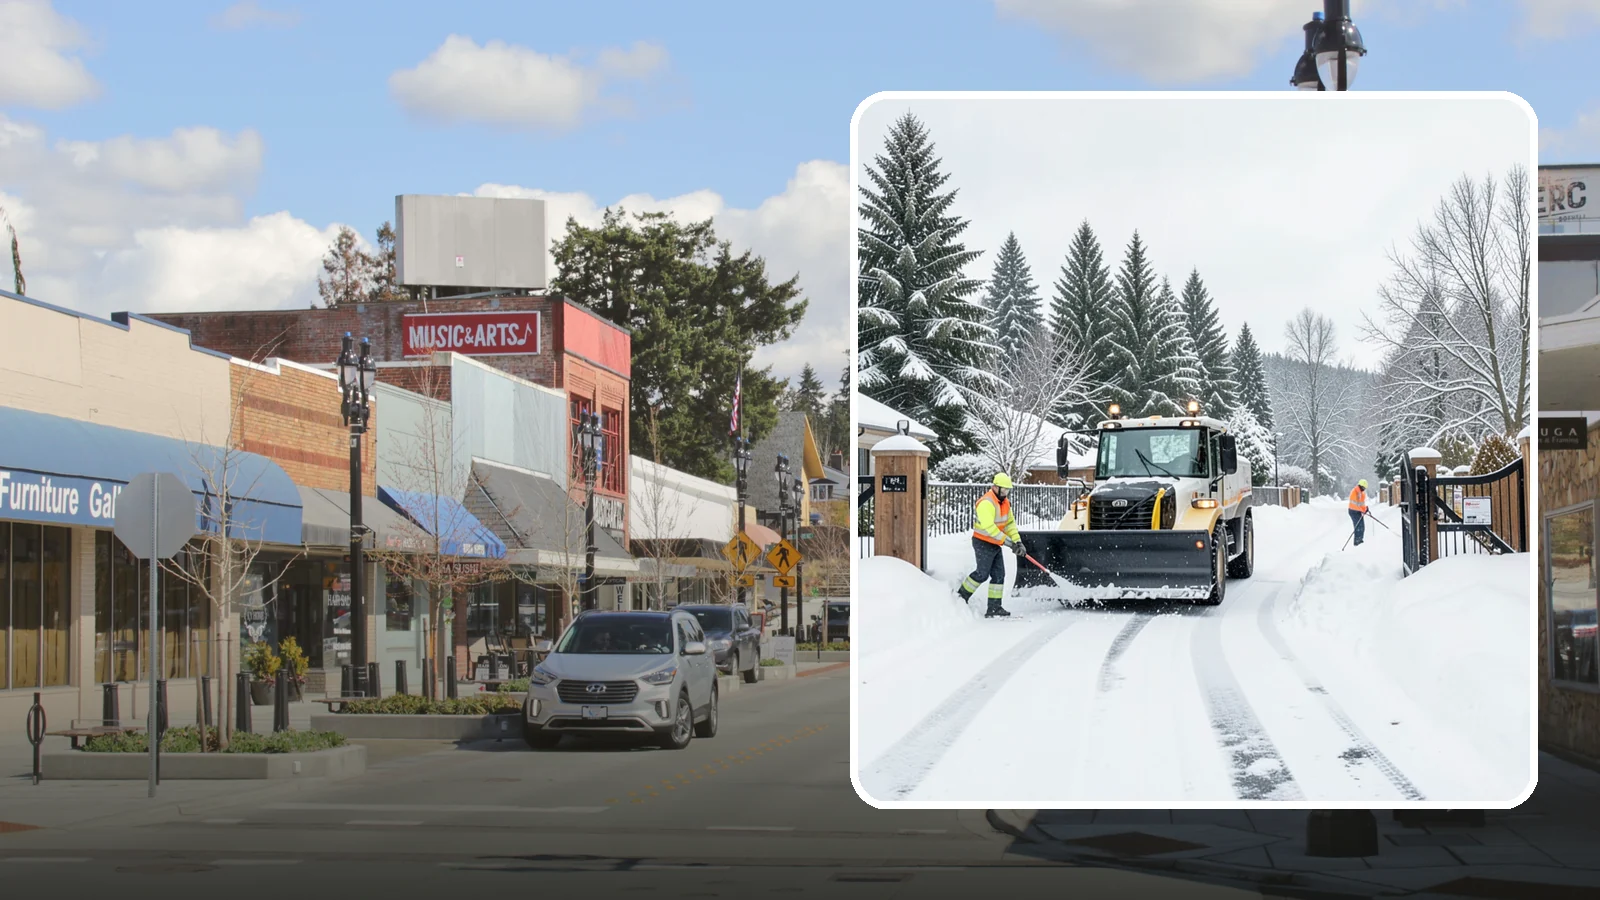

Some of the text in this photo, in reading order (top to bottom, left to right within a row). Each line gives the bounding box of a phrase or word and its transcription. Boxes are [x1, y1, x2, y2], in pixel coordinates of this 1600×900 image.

[408, 323, 520, 349] MUSIC&ARTS
[0, 471, 121, 519] Furniture Gal
[453, 563, 479, 574] SUSHI
